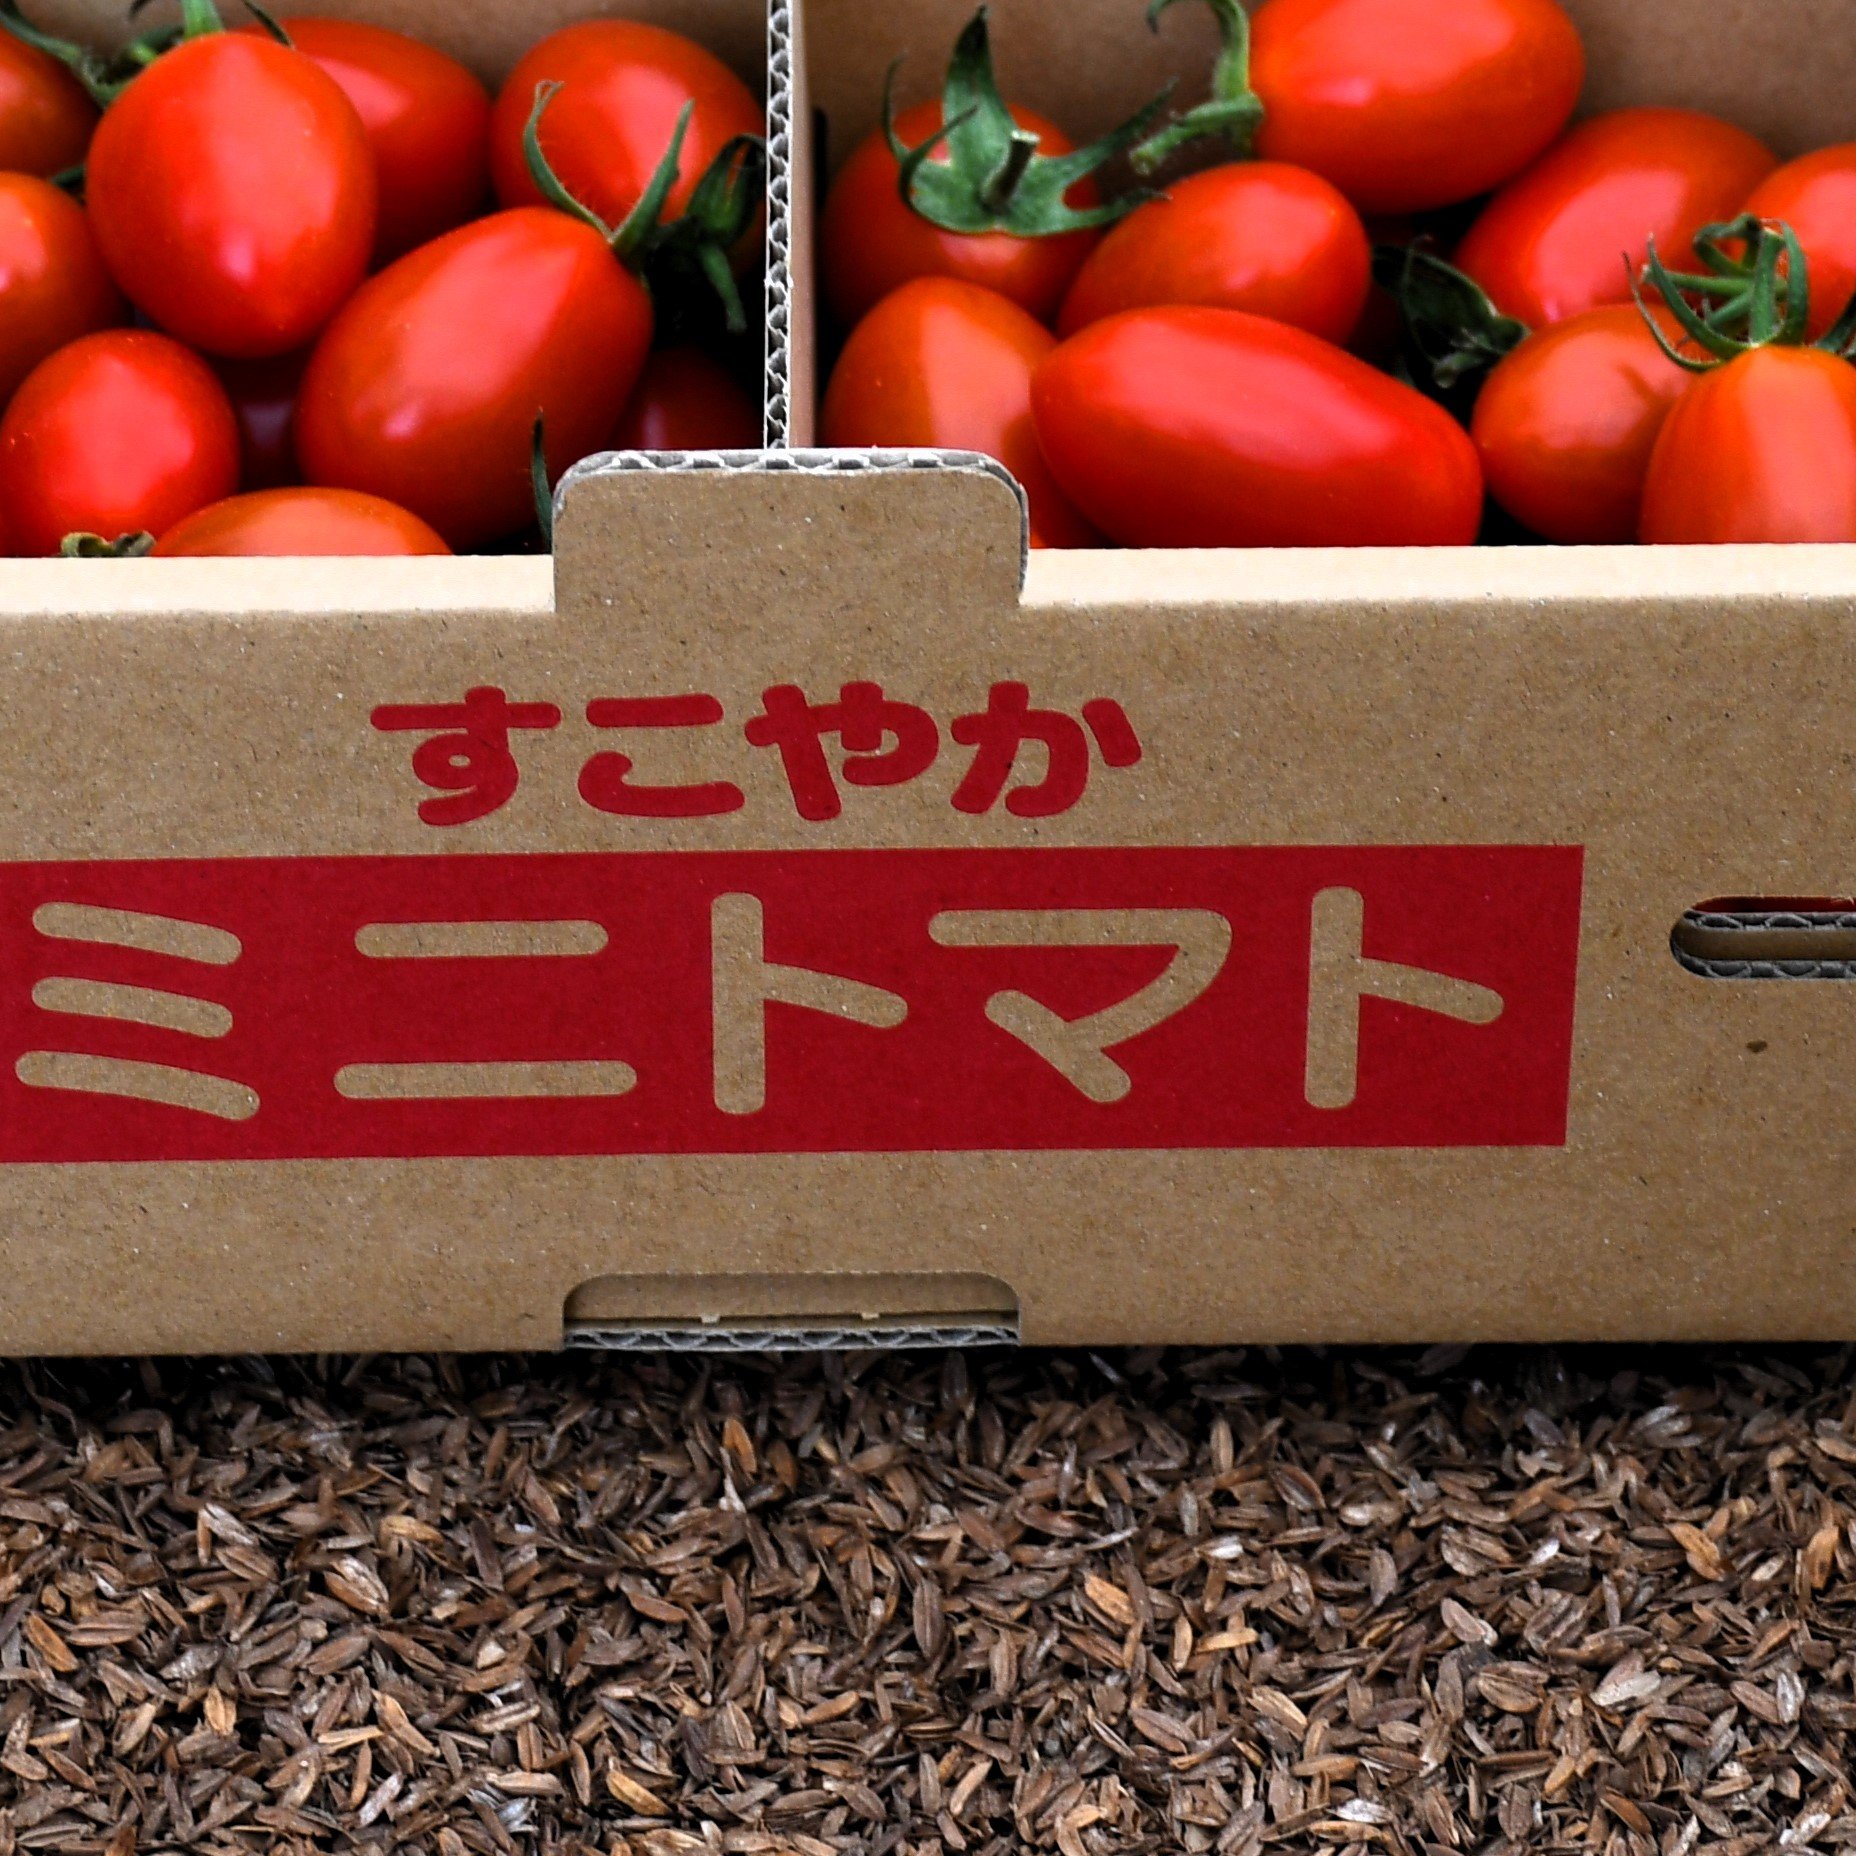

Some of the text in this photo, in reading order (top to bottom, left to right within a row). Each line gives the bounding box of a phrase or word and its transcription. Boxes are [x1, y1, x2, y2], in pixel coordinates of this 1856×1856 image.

[370, 682, 1142, 826] すこやか
[16, 888, 1503, 1120] ミニトマト
